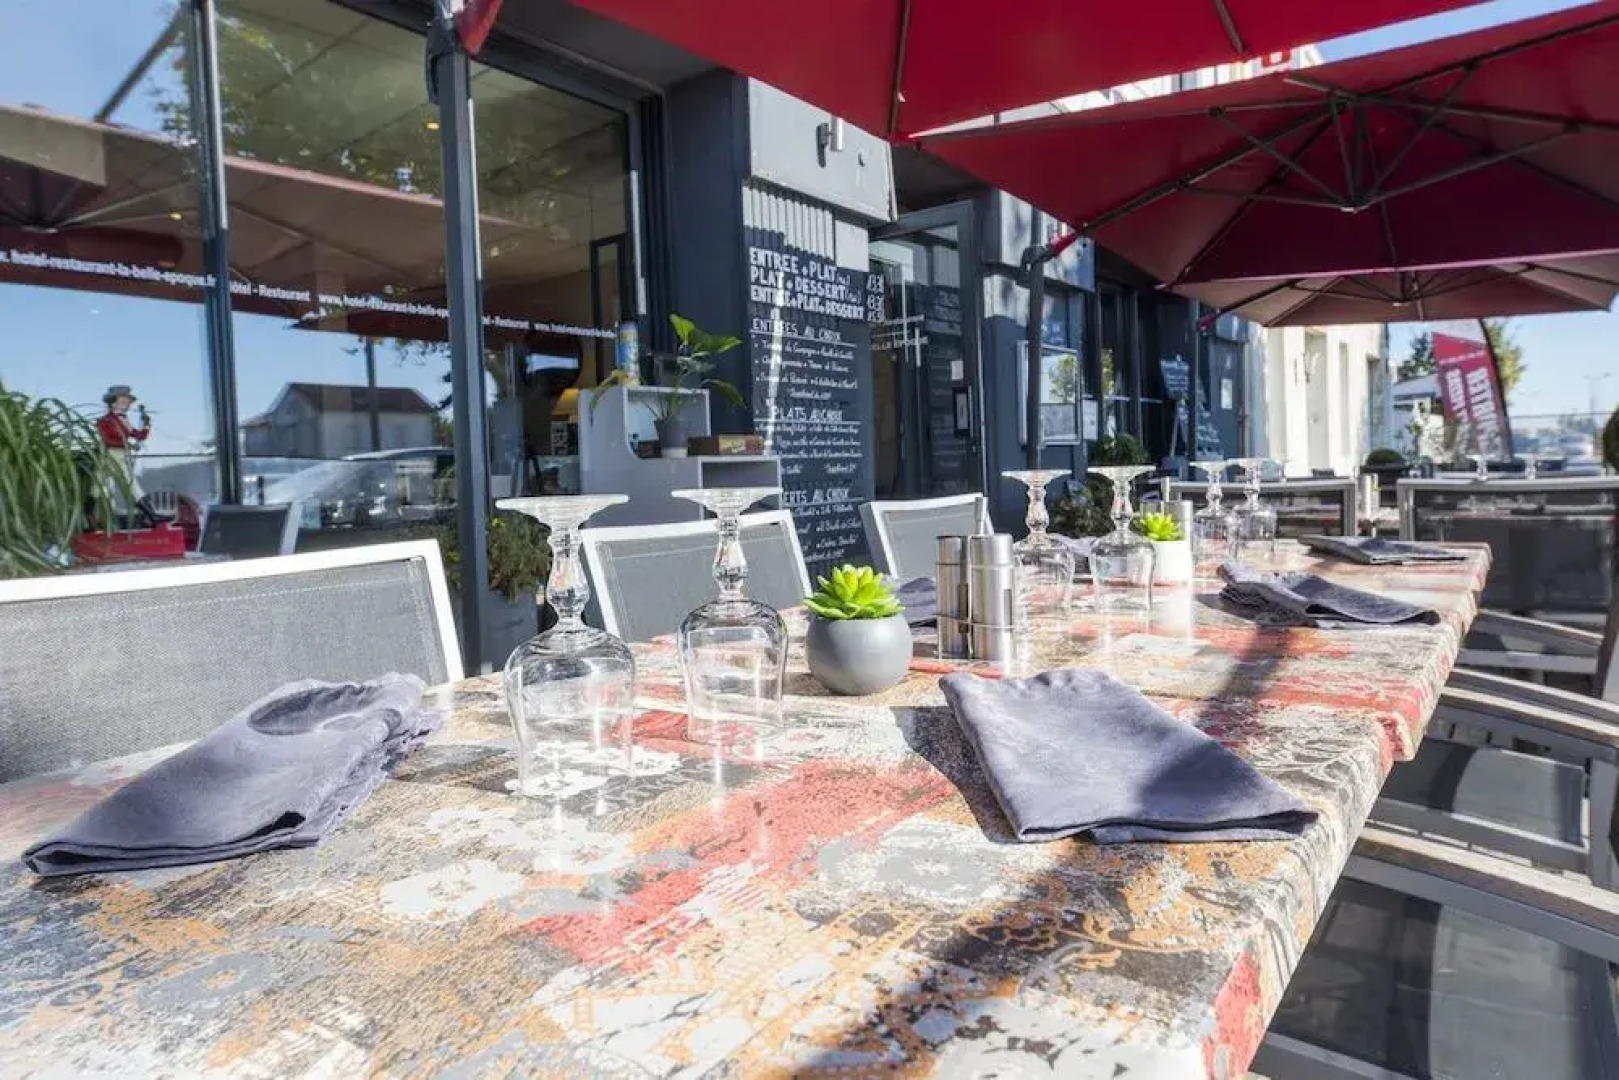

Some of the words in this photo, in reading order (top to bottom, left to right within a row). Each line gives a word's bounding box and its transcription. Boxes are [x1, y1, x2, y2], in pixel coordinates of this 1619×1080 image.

[809, 261, 837, 284] PLAT
[259, 284, 311, 302] Restaurant
[750, 266, 785, 290] PLAT
[794, 276, 846, 302] DESSERT
[782, 490, 807, 505] ERTS
